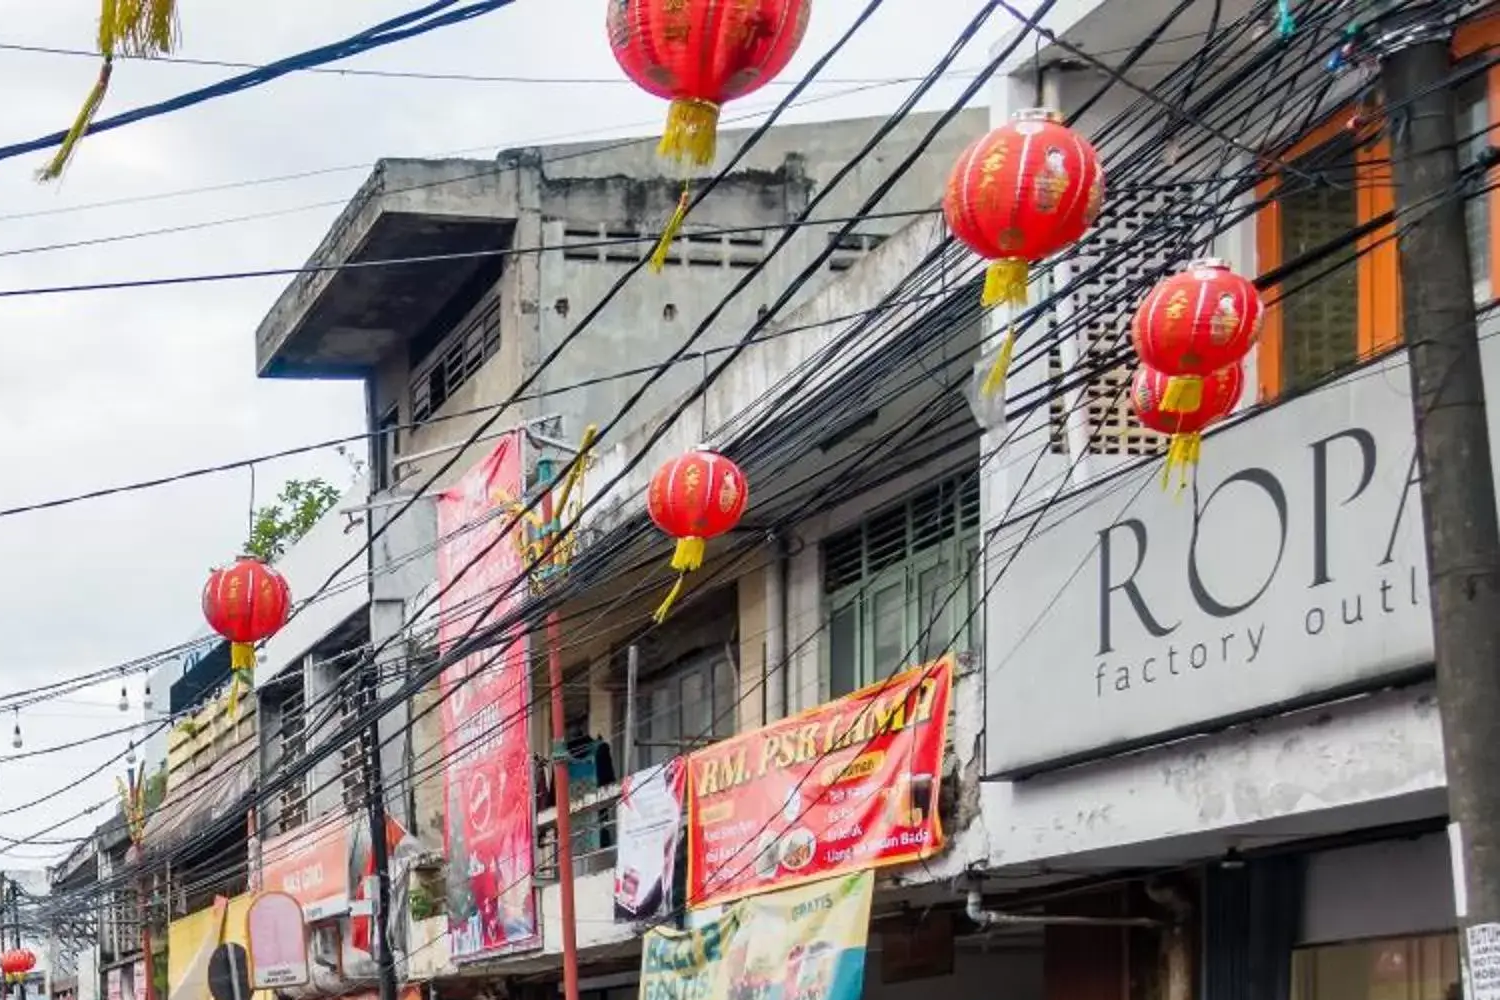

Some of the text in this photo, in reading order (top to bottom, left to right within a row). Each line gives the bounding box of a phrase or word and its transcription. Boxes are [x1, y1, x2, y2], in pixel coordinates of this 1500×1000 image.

[1095, 622, 1266, 698] factory
[698, 756, 751, 797] RM.
[758, 722, 821, 776] PSR
[791, 892, 834, 923] GRATIS
